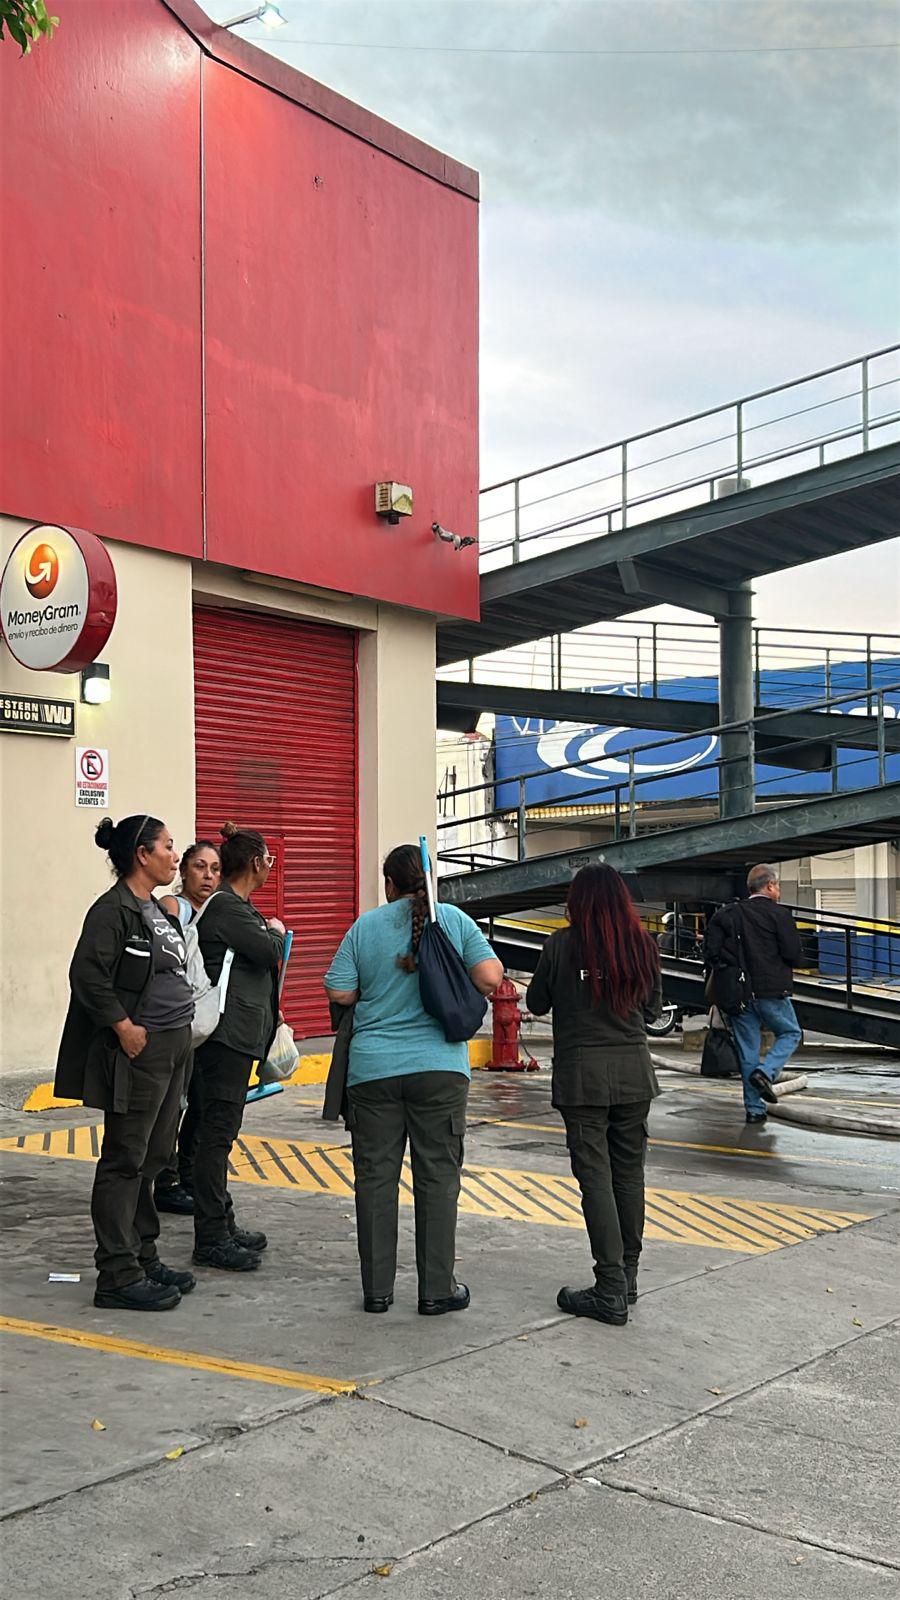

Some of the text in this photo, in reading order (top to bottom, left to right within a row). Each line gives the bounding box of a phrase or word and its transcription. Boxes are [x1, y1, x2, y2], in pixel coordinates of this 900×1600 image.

[8, 604, 79, 626] MoneyGram
[29, 627, 48, 637] recibo
[49, 625, 57, 634] de
[58, 623, 78, 633] dinero
[0, 699, 38, 712] ESTERN
[4, 709, 38, 722] UNION
[44, 704, 72, 725] WU
[79, 789, 104, 798] EXCLUSIVO
[78, 797, 98, 805] CLIENTES
